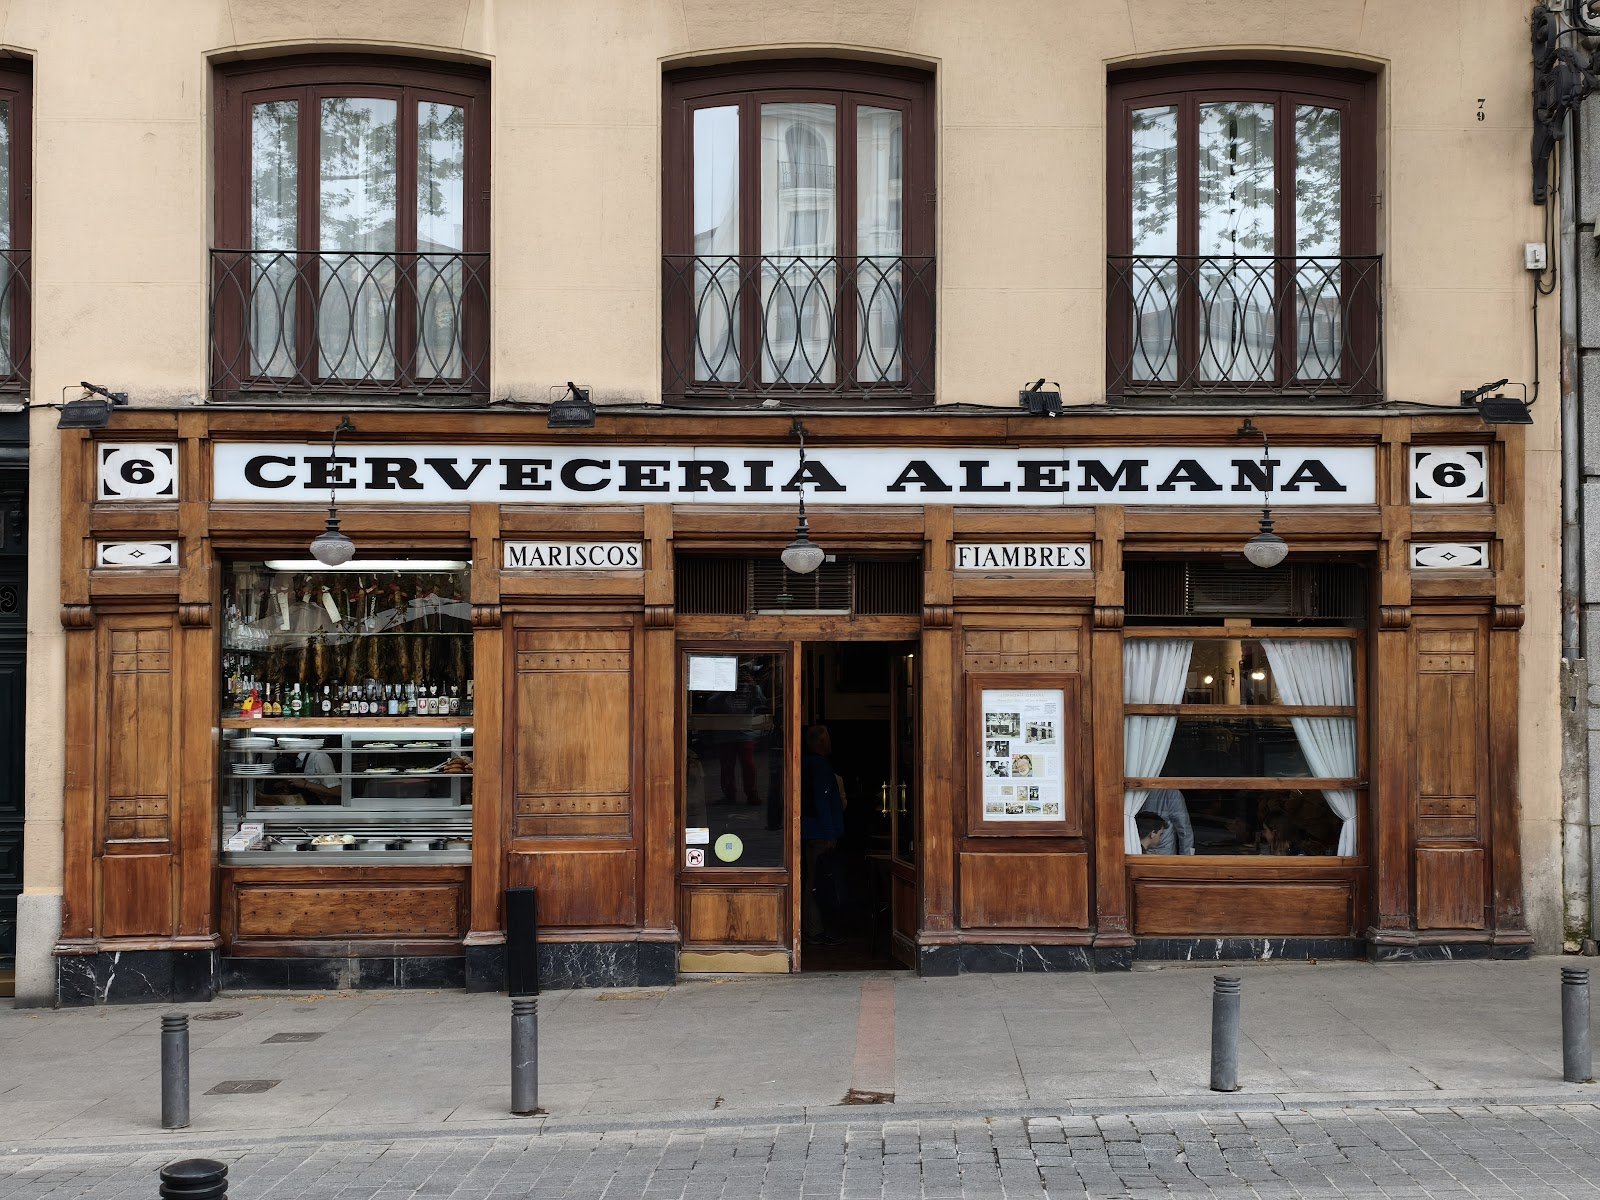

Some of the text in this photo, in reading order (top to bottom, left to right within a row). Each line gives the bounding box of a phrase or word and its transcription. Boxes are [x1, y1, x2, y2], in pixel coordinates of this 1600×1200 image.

[120, 459, 155, 485] 6
[244, 456, 1347, 493] CERVECERIA ALEMANA
[1432, 462, 1467, 488] 6
[508, 545, 639, 567] MARISCOS
[958, 546, 1088, 568] FIAMBRES
